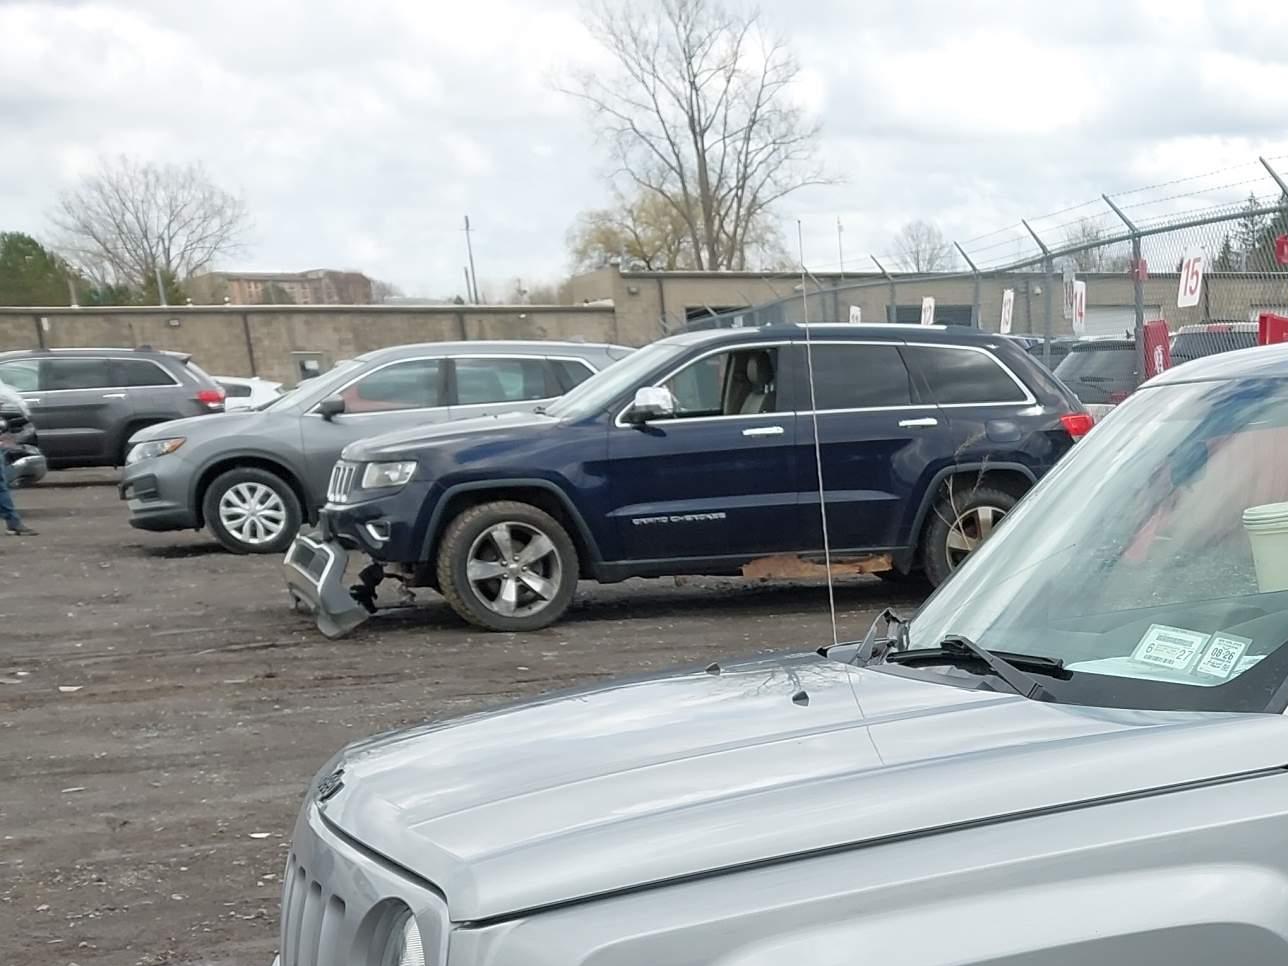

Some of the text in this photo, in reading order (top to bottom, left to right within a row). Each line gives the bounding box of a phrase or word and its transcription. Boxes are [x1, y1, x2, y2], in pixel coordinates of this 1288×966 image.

[1183, 257, 1202, 297] 15
[1074, 290, 1084, 323] 14
[1145, 643, 1155, 653] 6
[1176, 649, 1194, 662] 27
